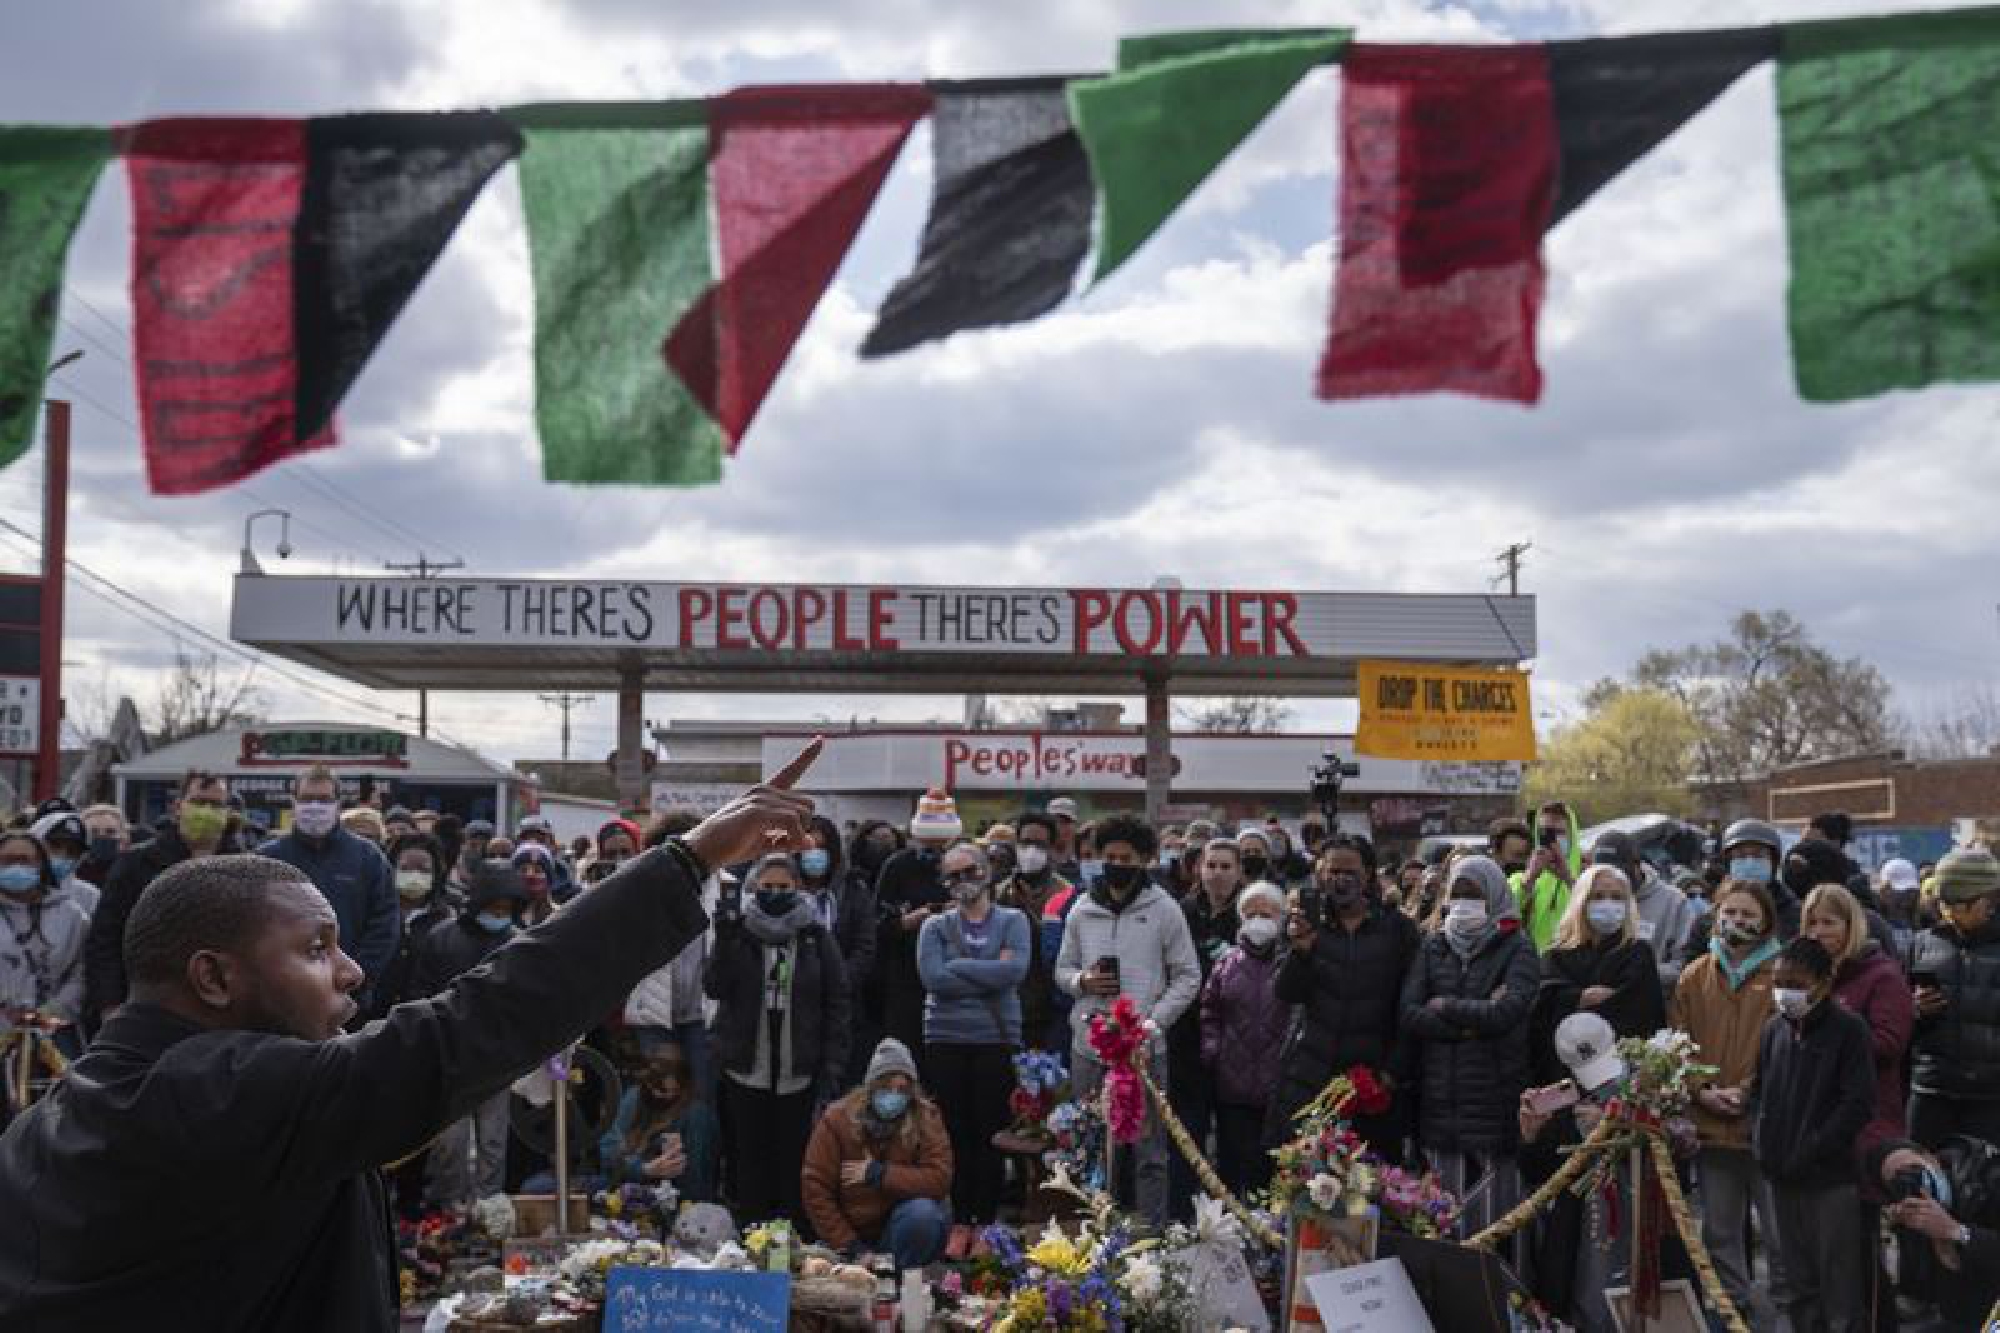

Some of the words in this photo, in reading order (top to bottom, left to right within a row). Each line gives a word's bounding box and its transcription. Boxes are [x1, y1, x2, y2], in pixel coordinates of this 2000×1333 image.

[338, 583, 477, 634] WHERE
[499, 582, 653, 643] THERE'S
[679, 587, 898, 650] PEOPLE
[1068, 589, 1311, 656] POWER
[1377, 675, 1418, 711] DROP
[1423, 677, 1447, 713] THE
[1452, 679, 1518, 714] CHARGES
